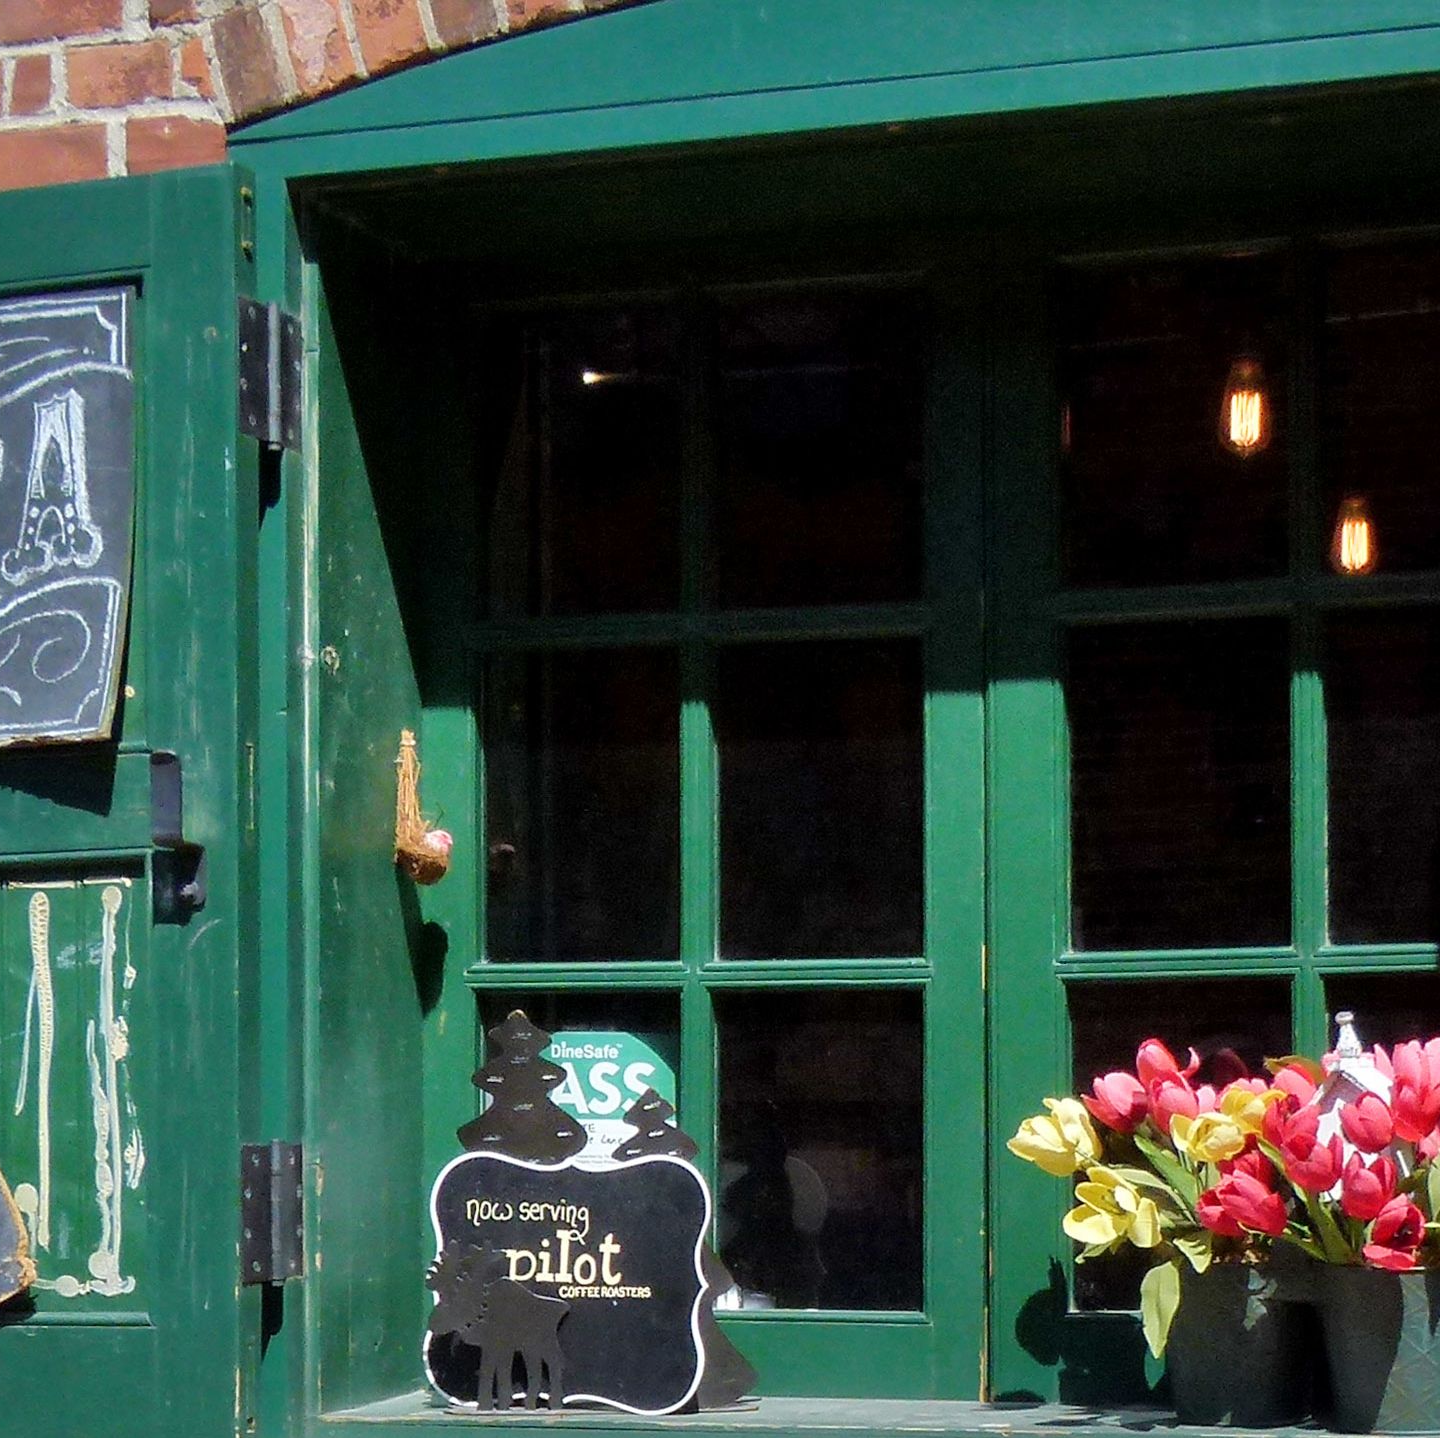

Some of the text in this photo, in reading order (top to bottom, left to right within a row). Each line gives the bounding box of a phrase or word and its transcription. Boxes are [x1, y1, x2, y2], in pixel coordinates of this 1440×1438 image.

[550, 1041, 620, 1059] DineSafe
[549, 1061, 657, 1116] ASS
[466, 1198, 589, 1246] now serving
[506, 1229, 622, 1286] pilot
[558, 1285, 652, 1299] COFFEE ROASTERS
